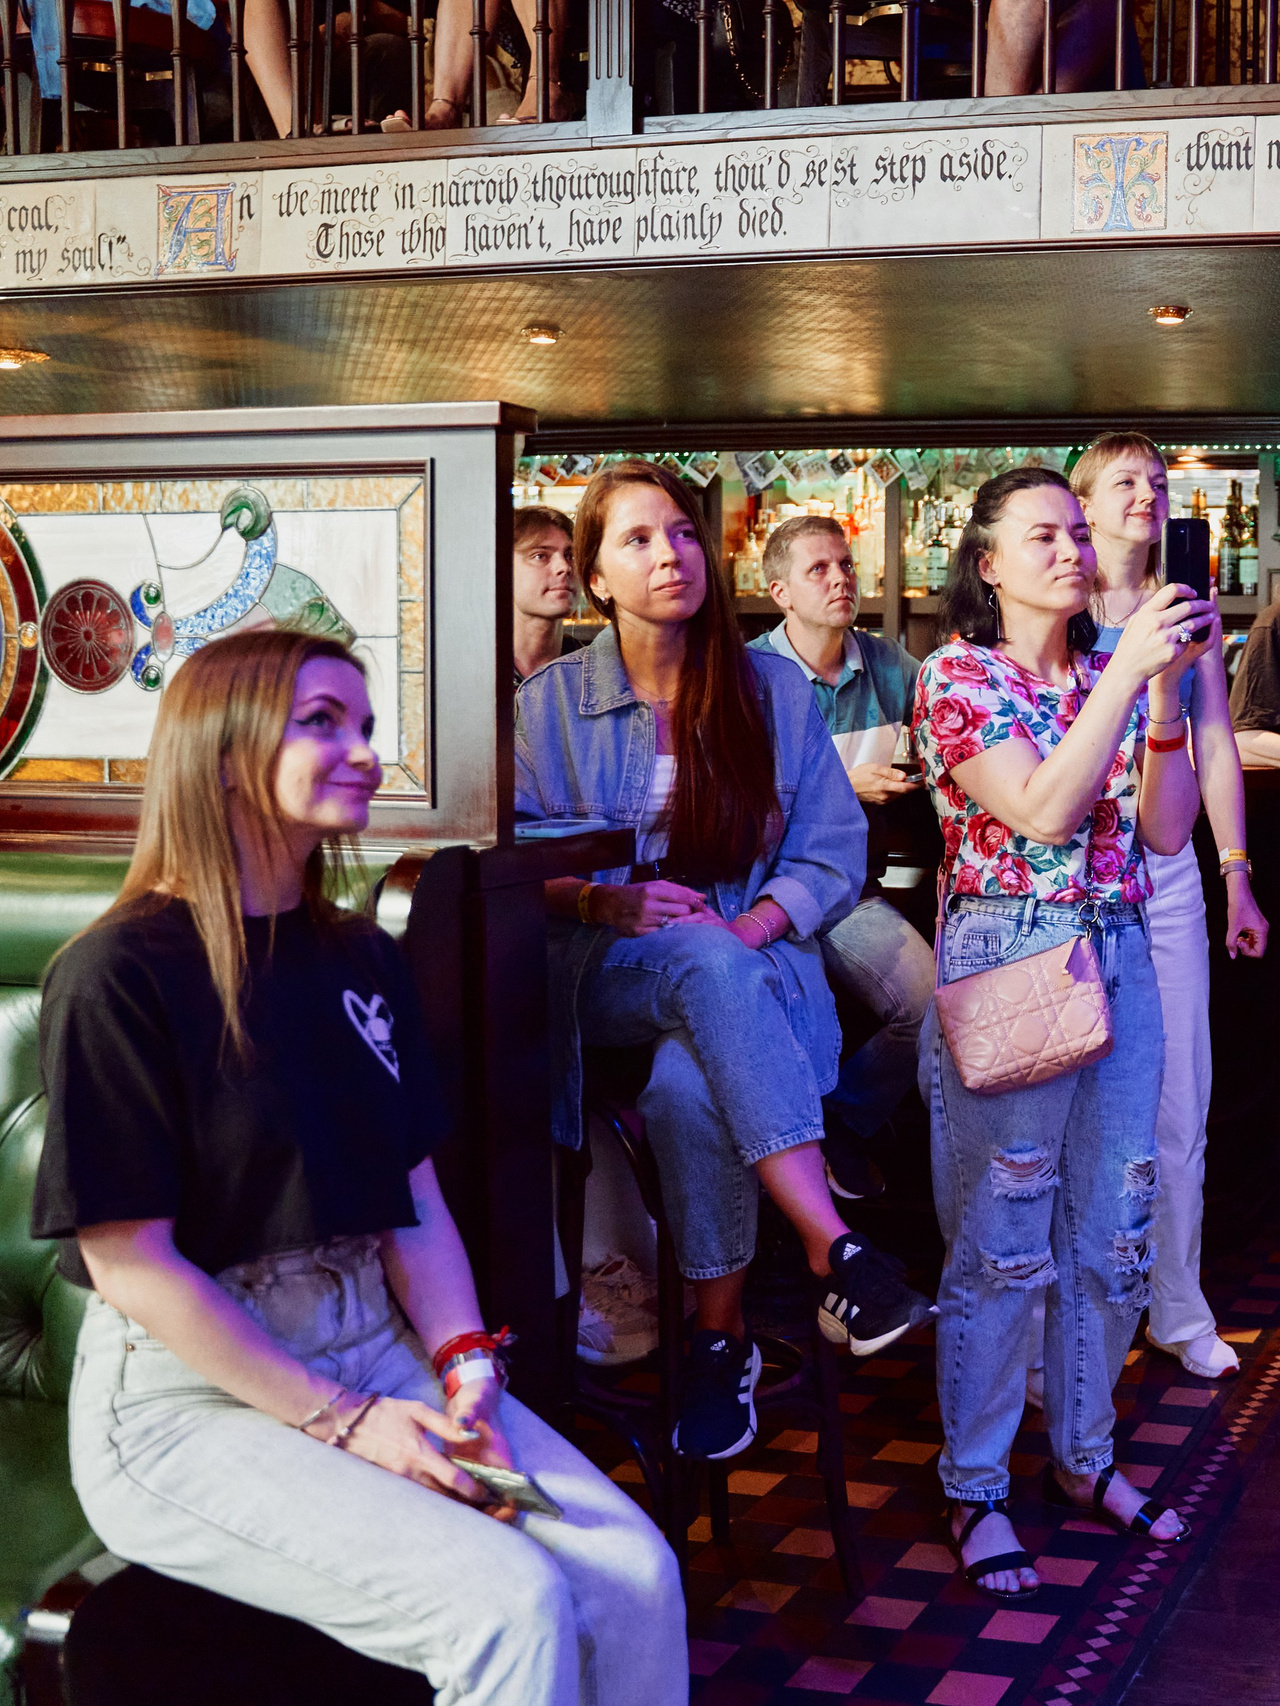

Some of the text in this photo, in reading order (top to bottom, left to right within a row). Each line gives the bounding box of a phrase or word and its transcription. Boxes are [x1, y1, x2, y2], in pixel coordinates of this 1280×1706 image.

[1185, 131, 1253, 171] want
[275, 182, 308, 217] we
[320, 181, 379, 214] meete
[394, 181, 415, 211] in
[431, 168, 519, 209] narrow
[714, 148, 790, 196] thou'd
[871, 152, 927, 199] step
[939, 140, 1013, 182] aside.
[8, 196, 58, 233] coal,
[314, 197, 787, 263] Those who haven't, have plainly died.
[15, 248, 47, 280] my
